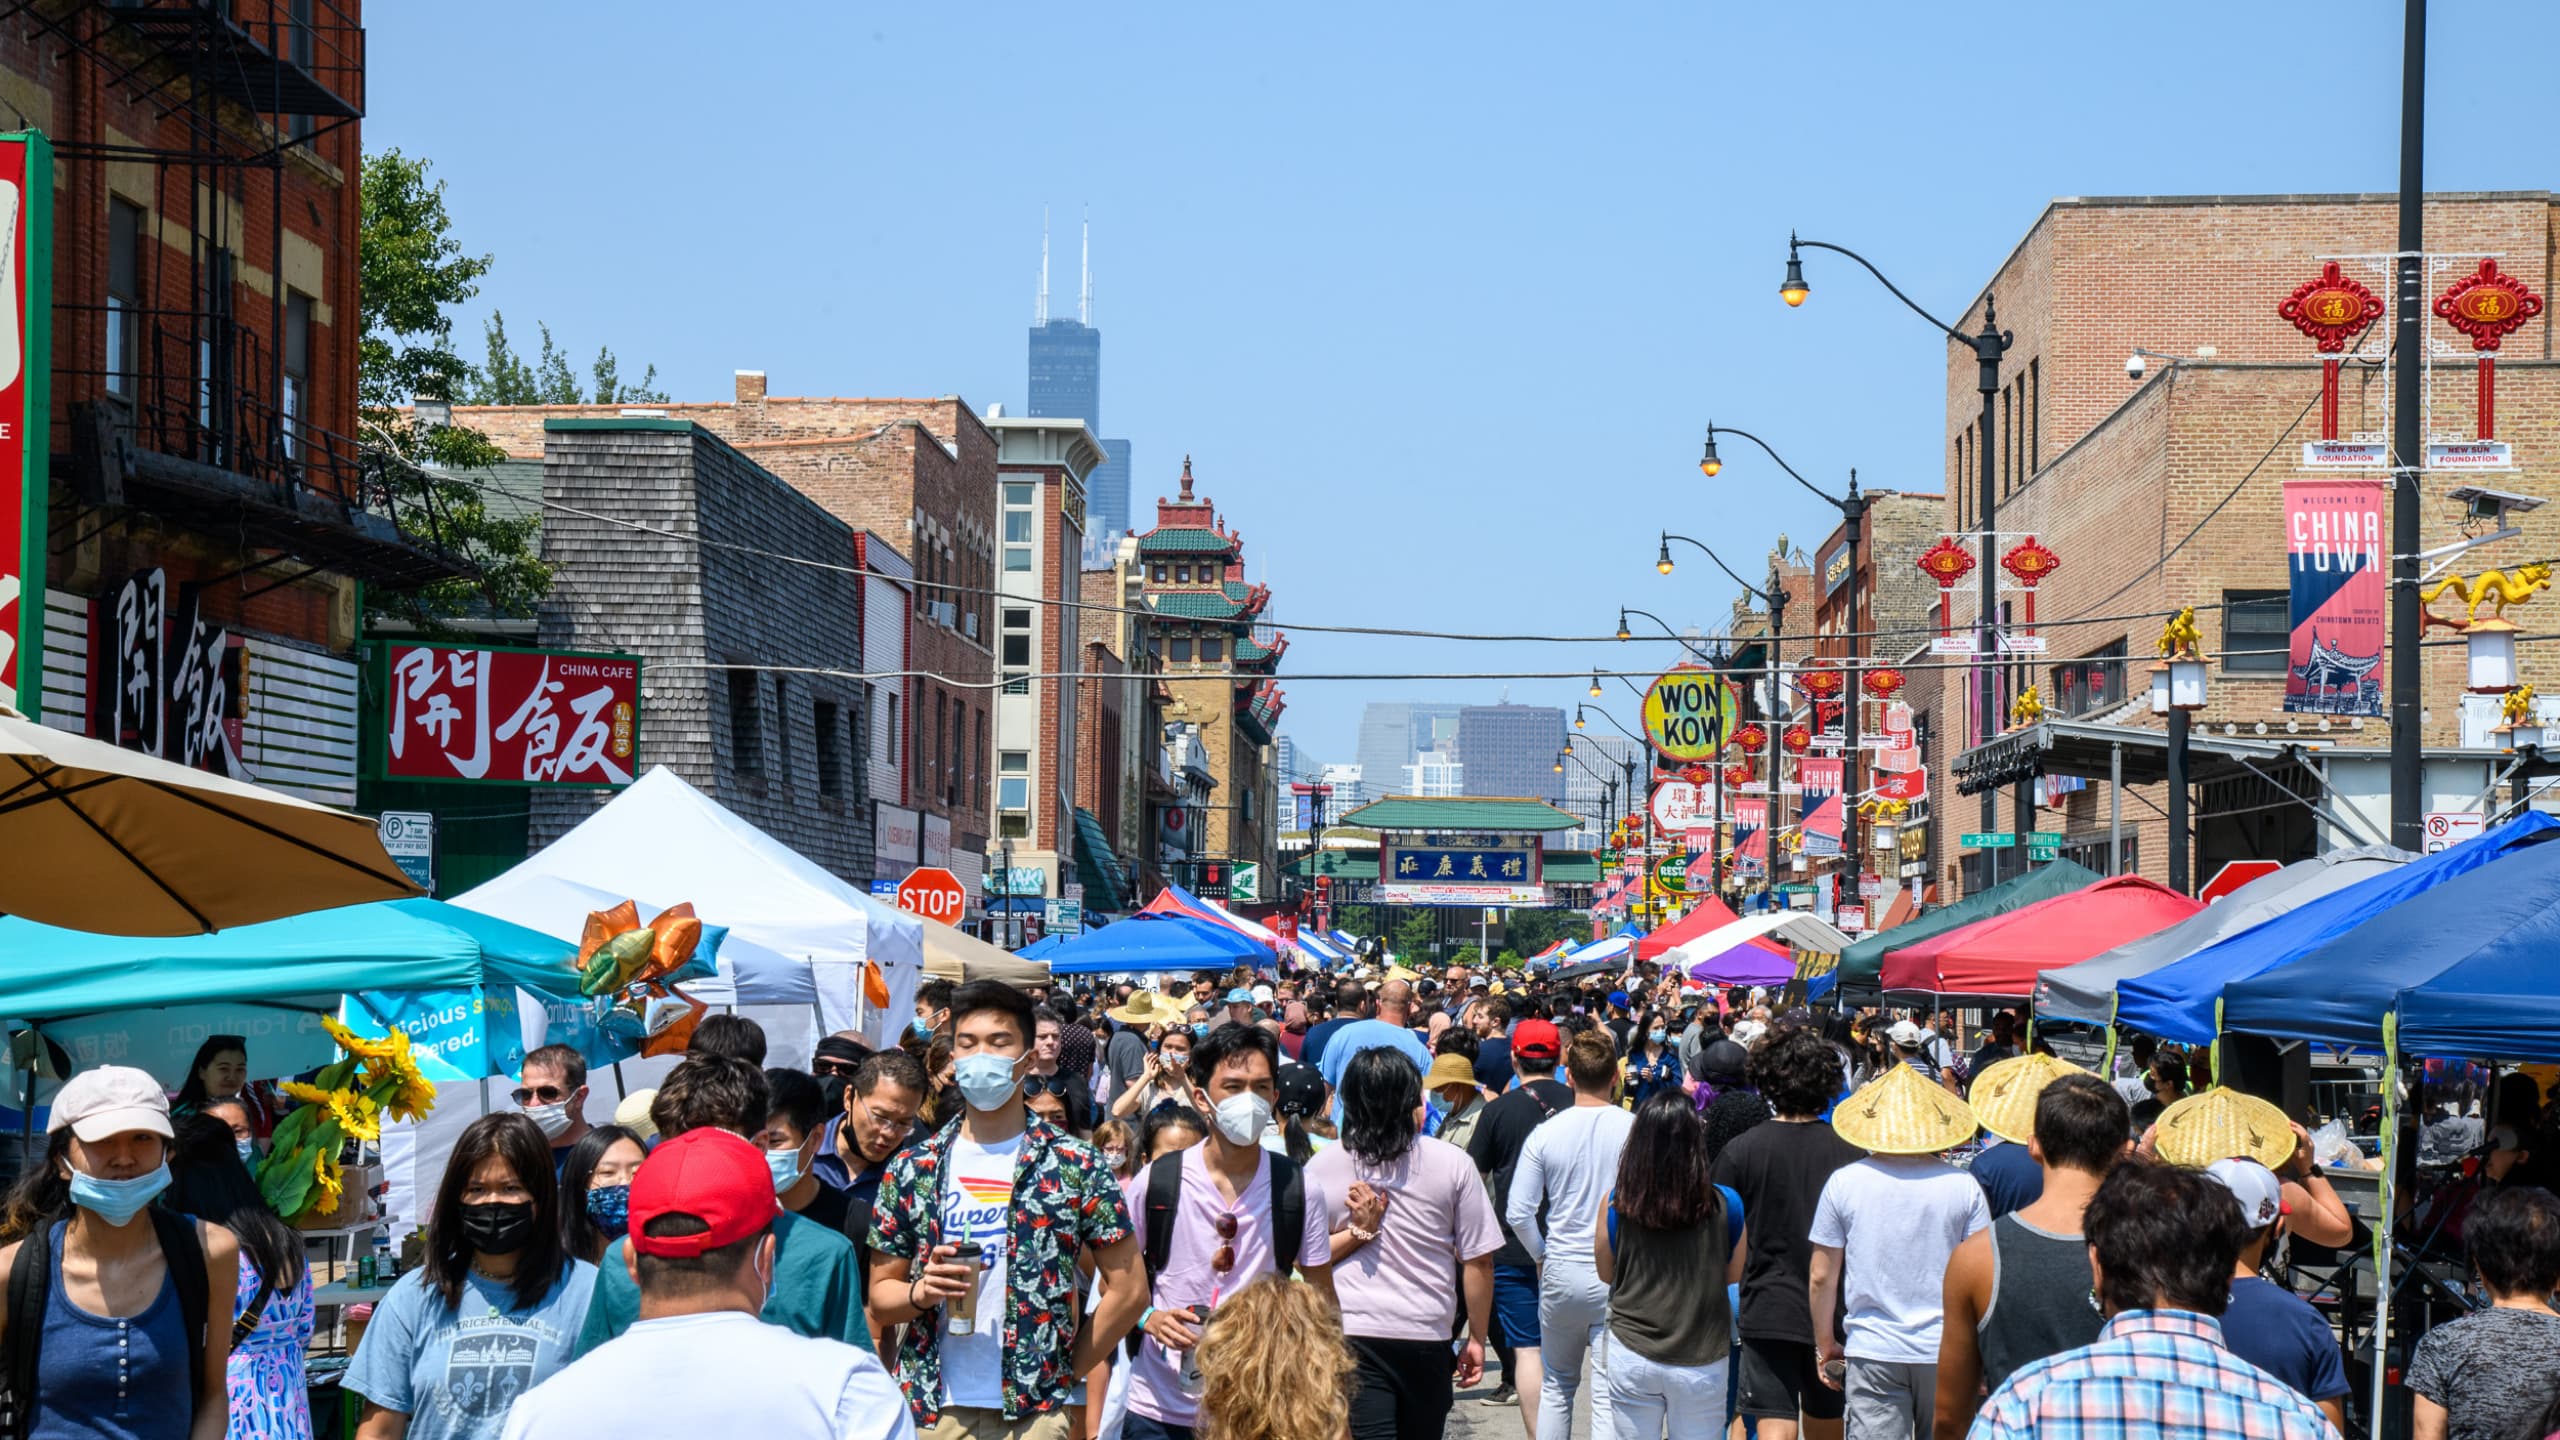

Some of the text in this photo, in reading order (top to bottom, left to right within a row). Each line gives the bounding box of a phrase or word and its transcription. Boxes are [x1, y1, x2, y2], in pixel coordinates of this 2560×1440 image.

[2324, 445, 2366, 453] NEW SUN
[2448, 446, 2490, 454] NEW SUN
[2316, 454, 2374, 463] FOUNDATION
[2439, 455, 2499, 464] FOUNDATION
[2303, 496, 2366, 505] WELCOME TO
[2293, 511, 2379, 541] CHINA
[2294, 541, 2379, 573] TOWN
[560, 664, 633, 679] CHINA CAFE
[1658, 683, 1721, 713] WON
[1663, 716, 1724, 747] KOW
[1804, 770, 1841, 784] CHINA
[1804, 783, 1841, 798] TOWN
[1736, 808, 1765, 820] CHINA
[1737, 819, 1765, 831] TOWN
[902, 888, 960, 915] STOP
[456, 1316, 541, 1330] TRICENTENNIAL
